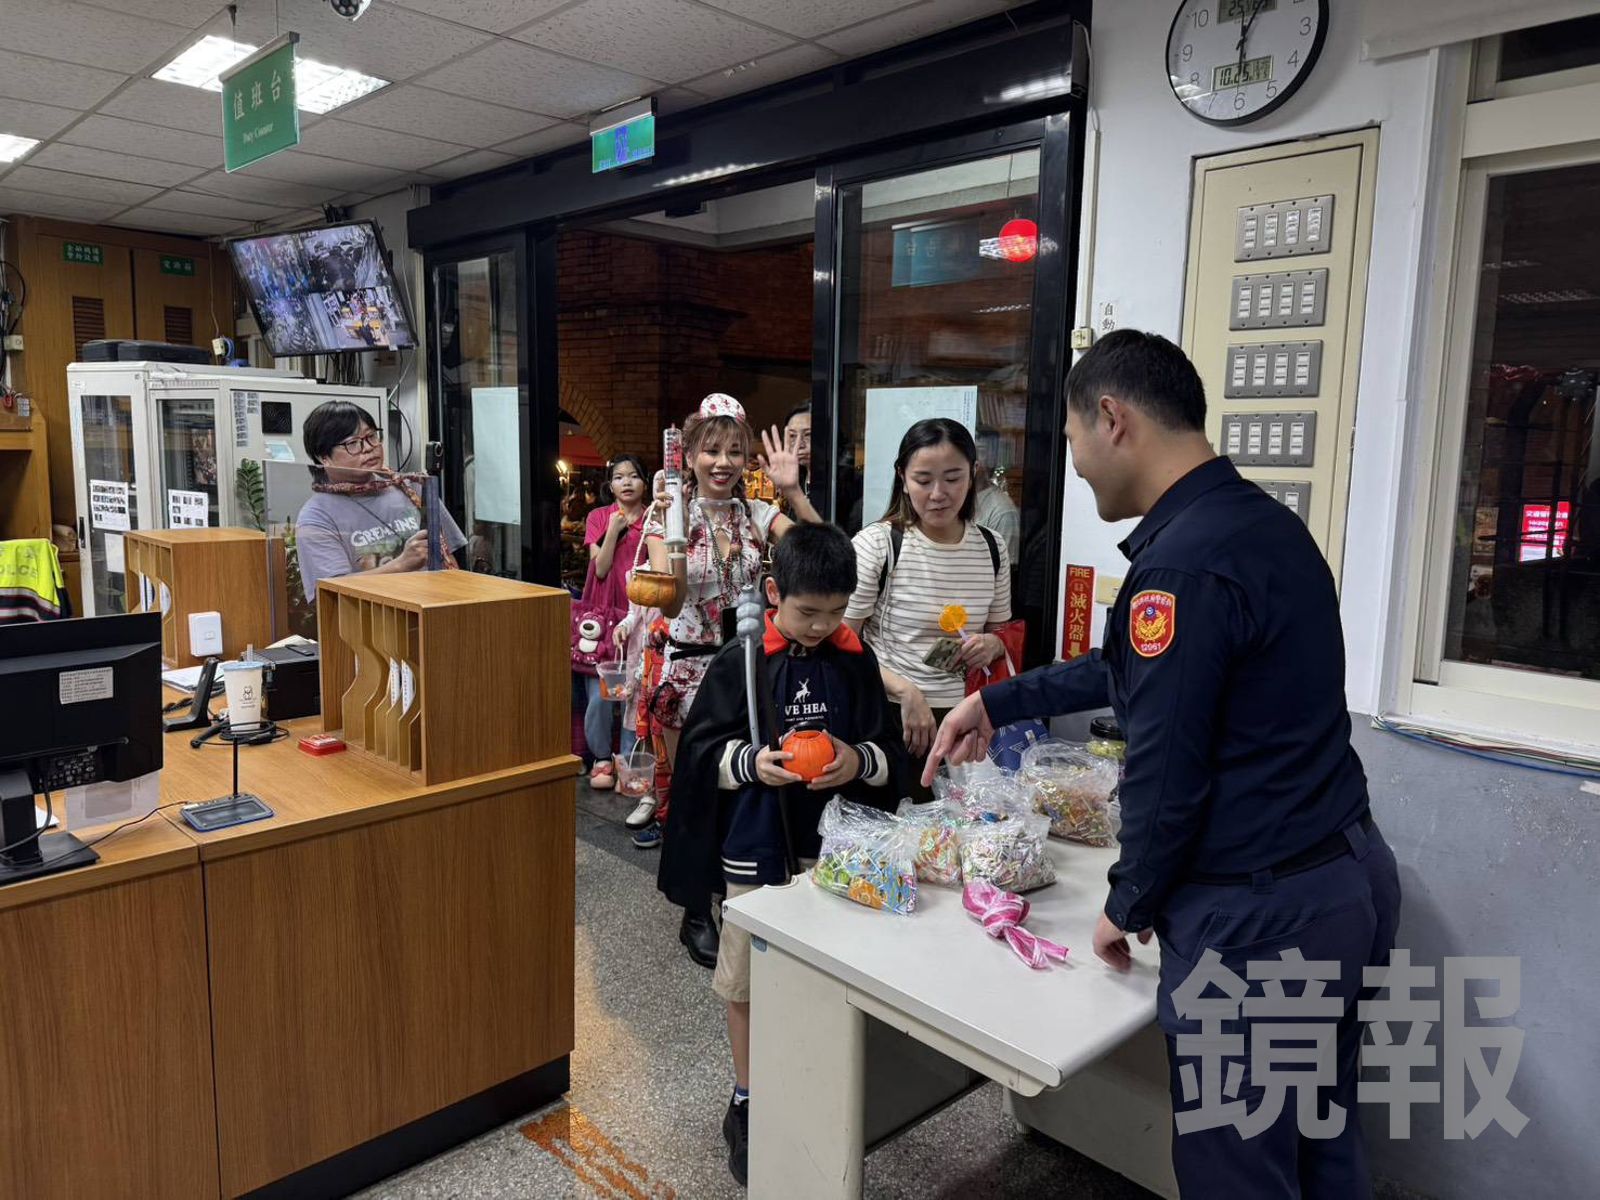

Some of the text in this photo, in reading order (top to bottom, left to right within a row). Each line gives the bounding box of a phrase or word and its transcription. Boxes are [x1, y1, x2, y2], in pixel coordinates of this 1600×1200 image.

[1193, 9, 1209, 28] 10
[1300, 16, 1312, 36] 3
[1182, 44, 1193, 62] 9
[1287, 49, 1300, 67] 4
[1190, 72, 1200, 88] 8
[1265, 80, 1278, 99] 5
[233, 70, 281, 120] 值班台
[1207, 92, 1218, 112] 7
[1233, 92, 1246, 111] 6
[1102, 302, 1115, 331] 自動
[1069, 566, 1090, 578] FIRE
[1068, 592, 1088, 641] 滅火器
